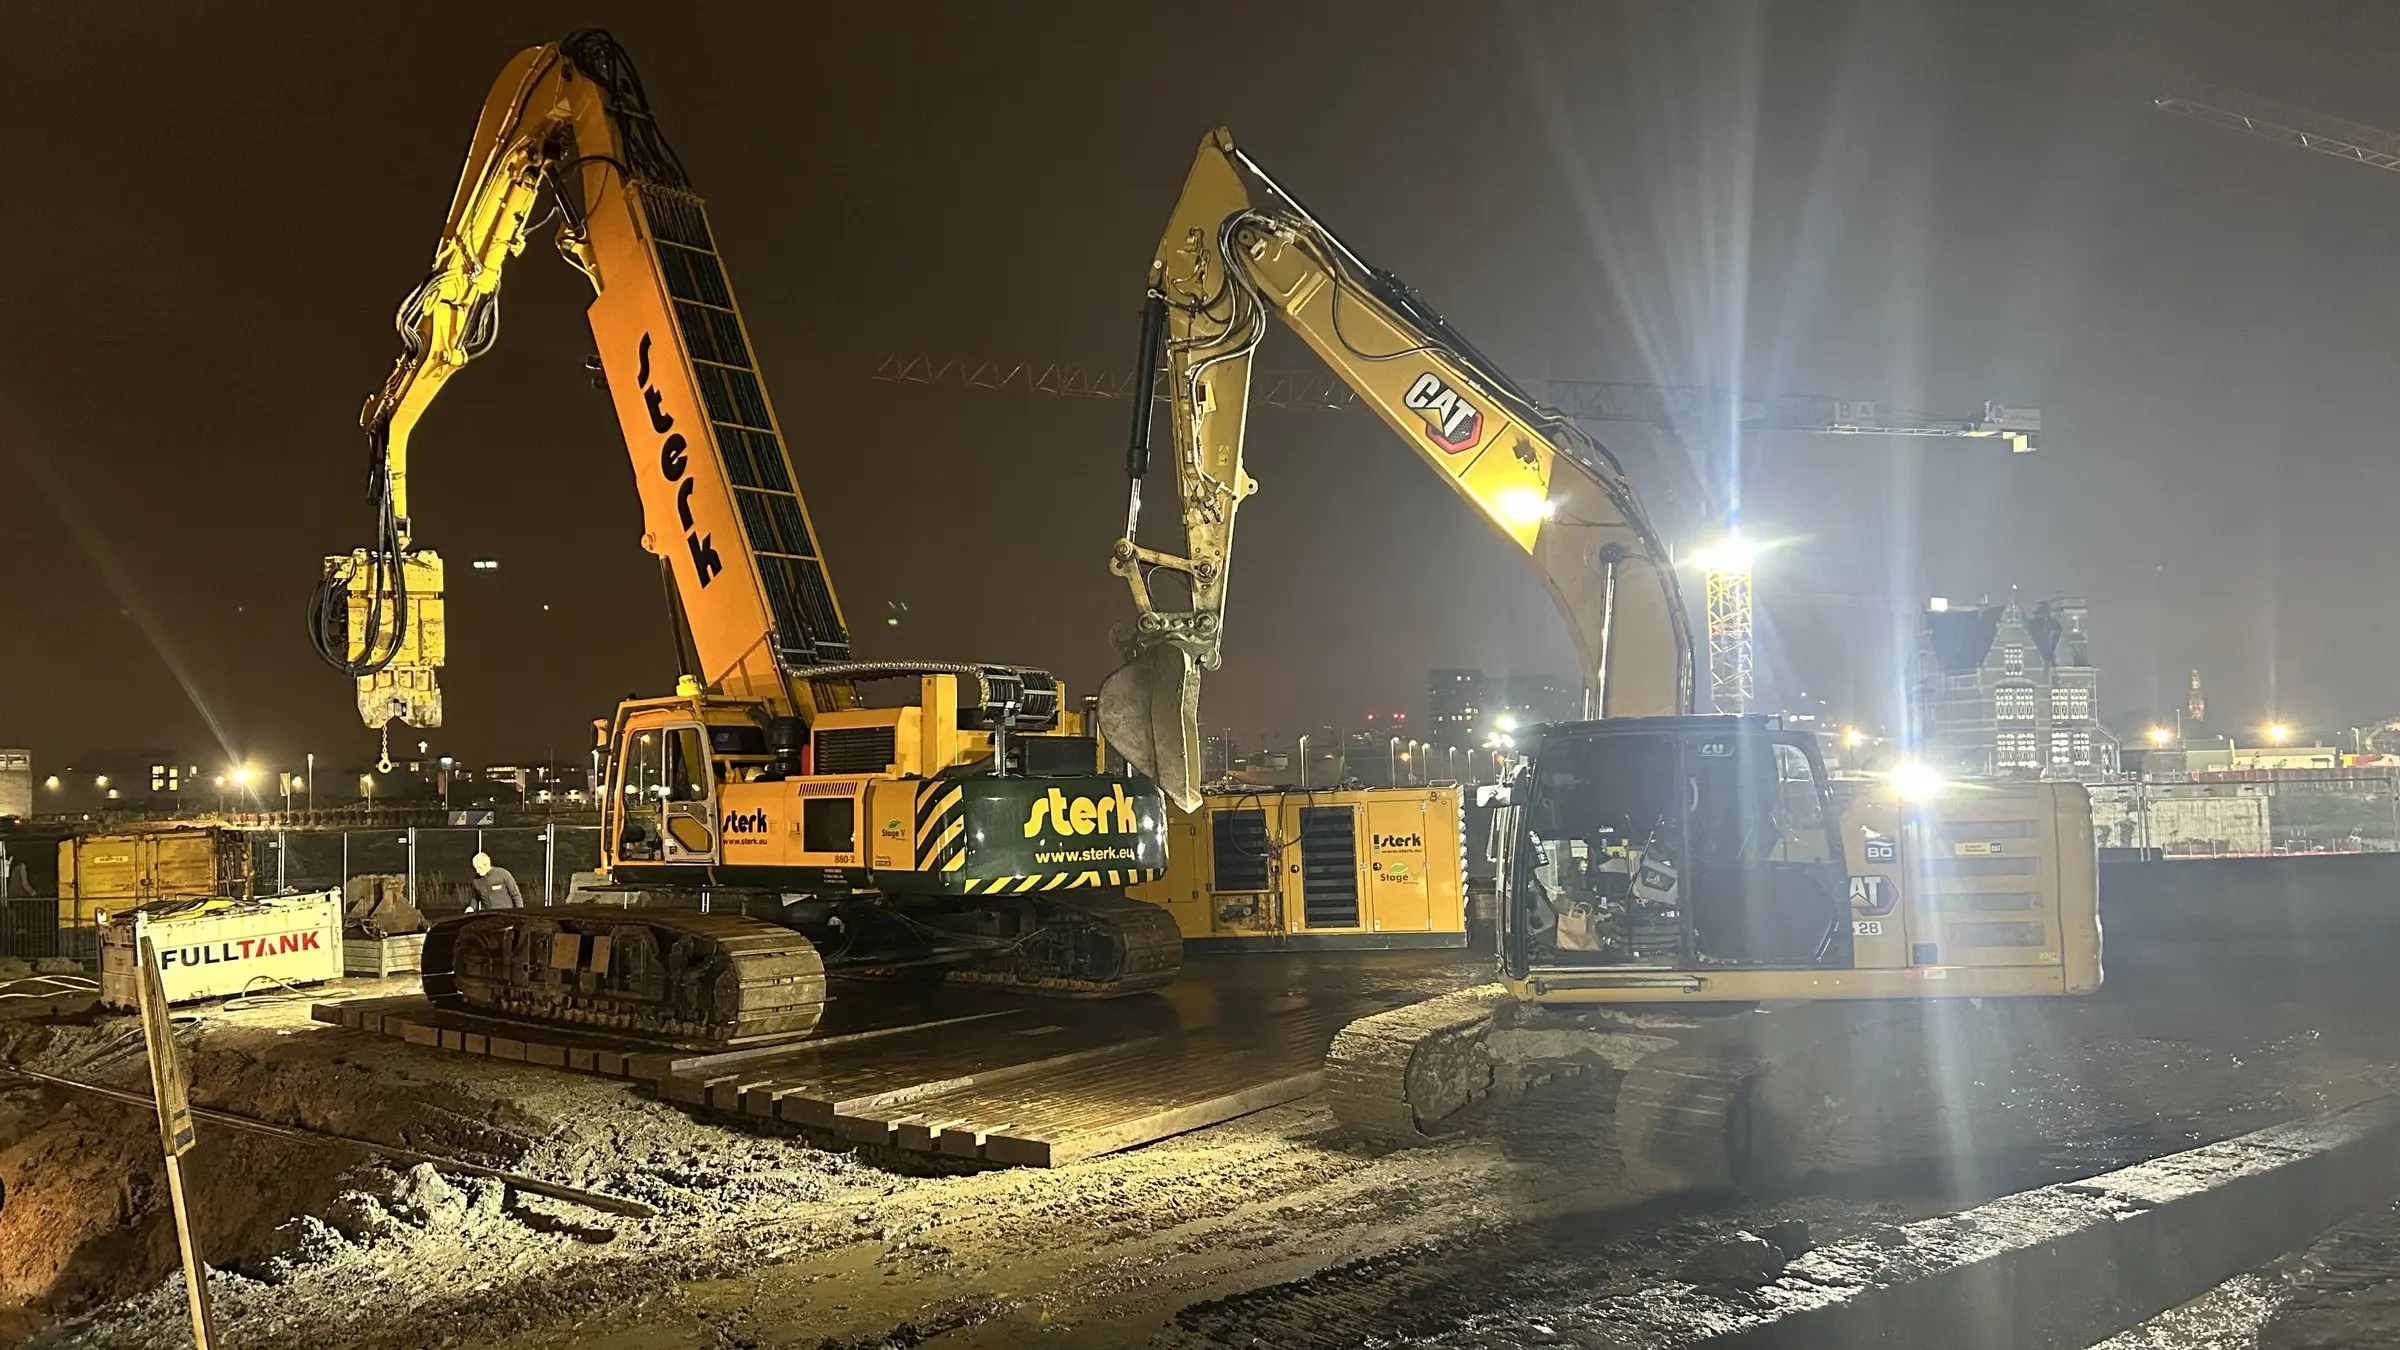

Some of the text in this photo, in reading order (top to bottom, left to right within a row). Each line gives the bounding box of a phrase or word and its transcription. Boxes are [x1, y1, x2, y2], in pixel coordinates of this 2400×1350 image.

[1405, 372, 1477, 437] CAT
[637, 331, 723, 589] sterk
[722, 807, 768, 833] sterk
[1023, 783, 1138, 838] sterk
[881, 828, 900, 839] Stage
[1381, 833, 1422, 847] sterk
[1035, 846, 1133, 864] www.sterk.eu
[1867, 847, 1893, 858] BO
[1380, 873, 1409, 883] Stage
[1849, 876, 1881, 907] AT
[1859, 922, 1879, 934] 28
[161, 931, 320, 970] FULLTANK
